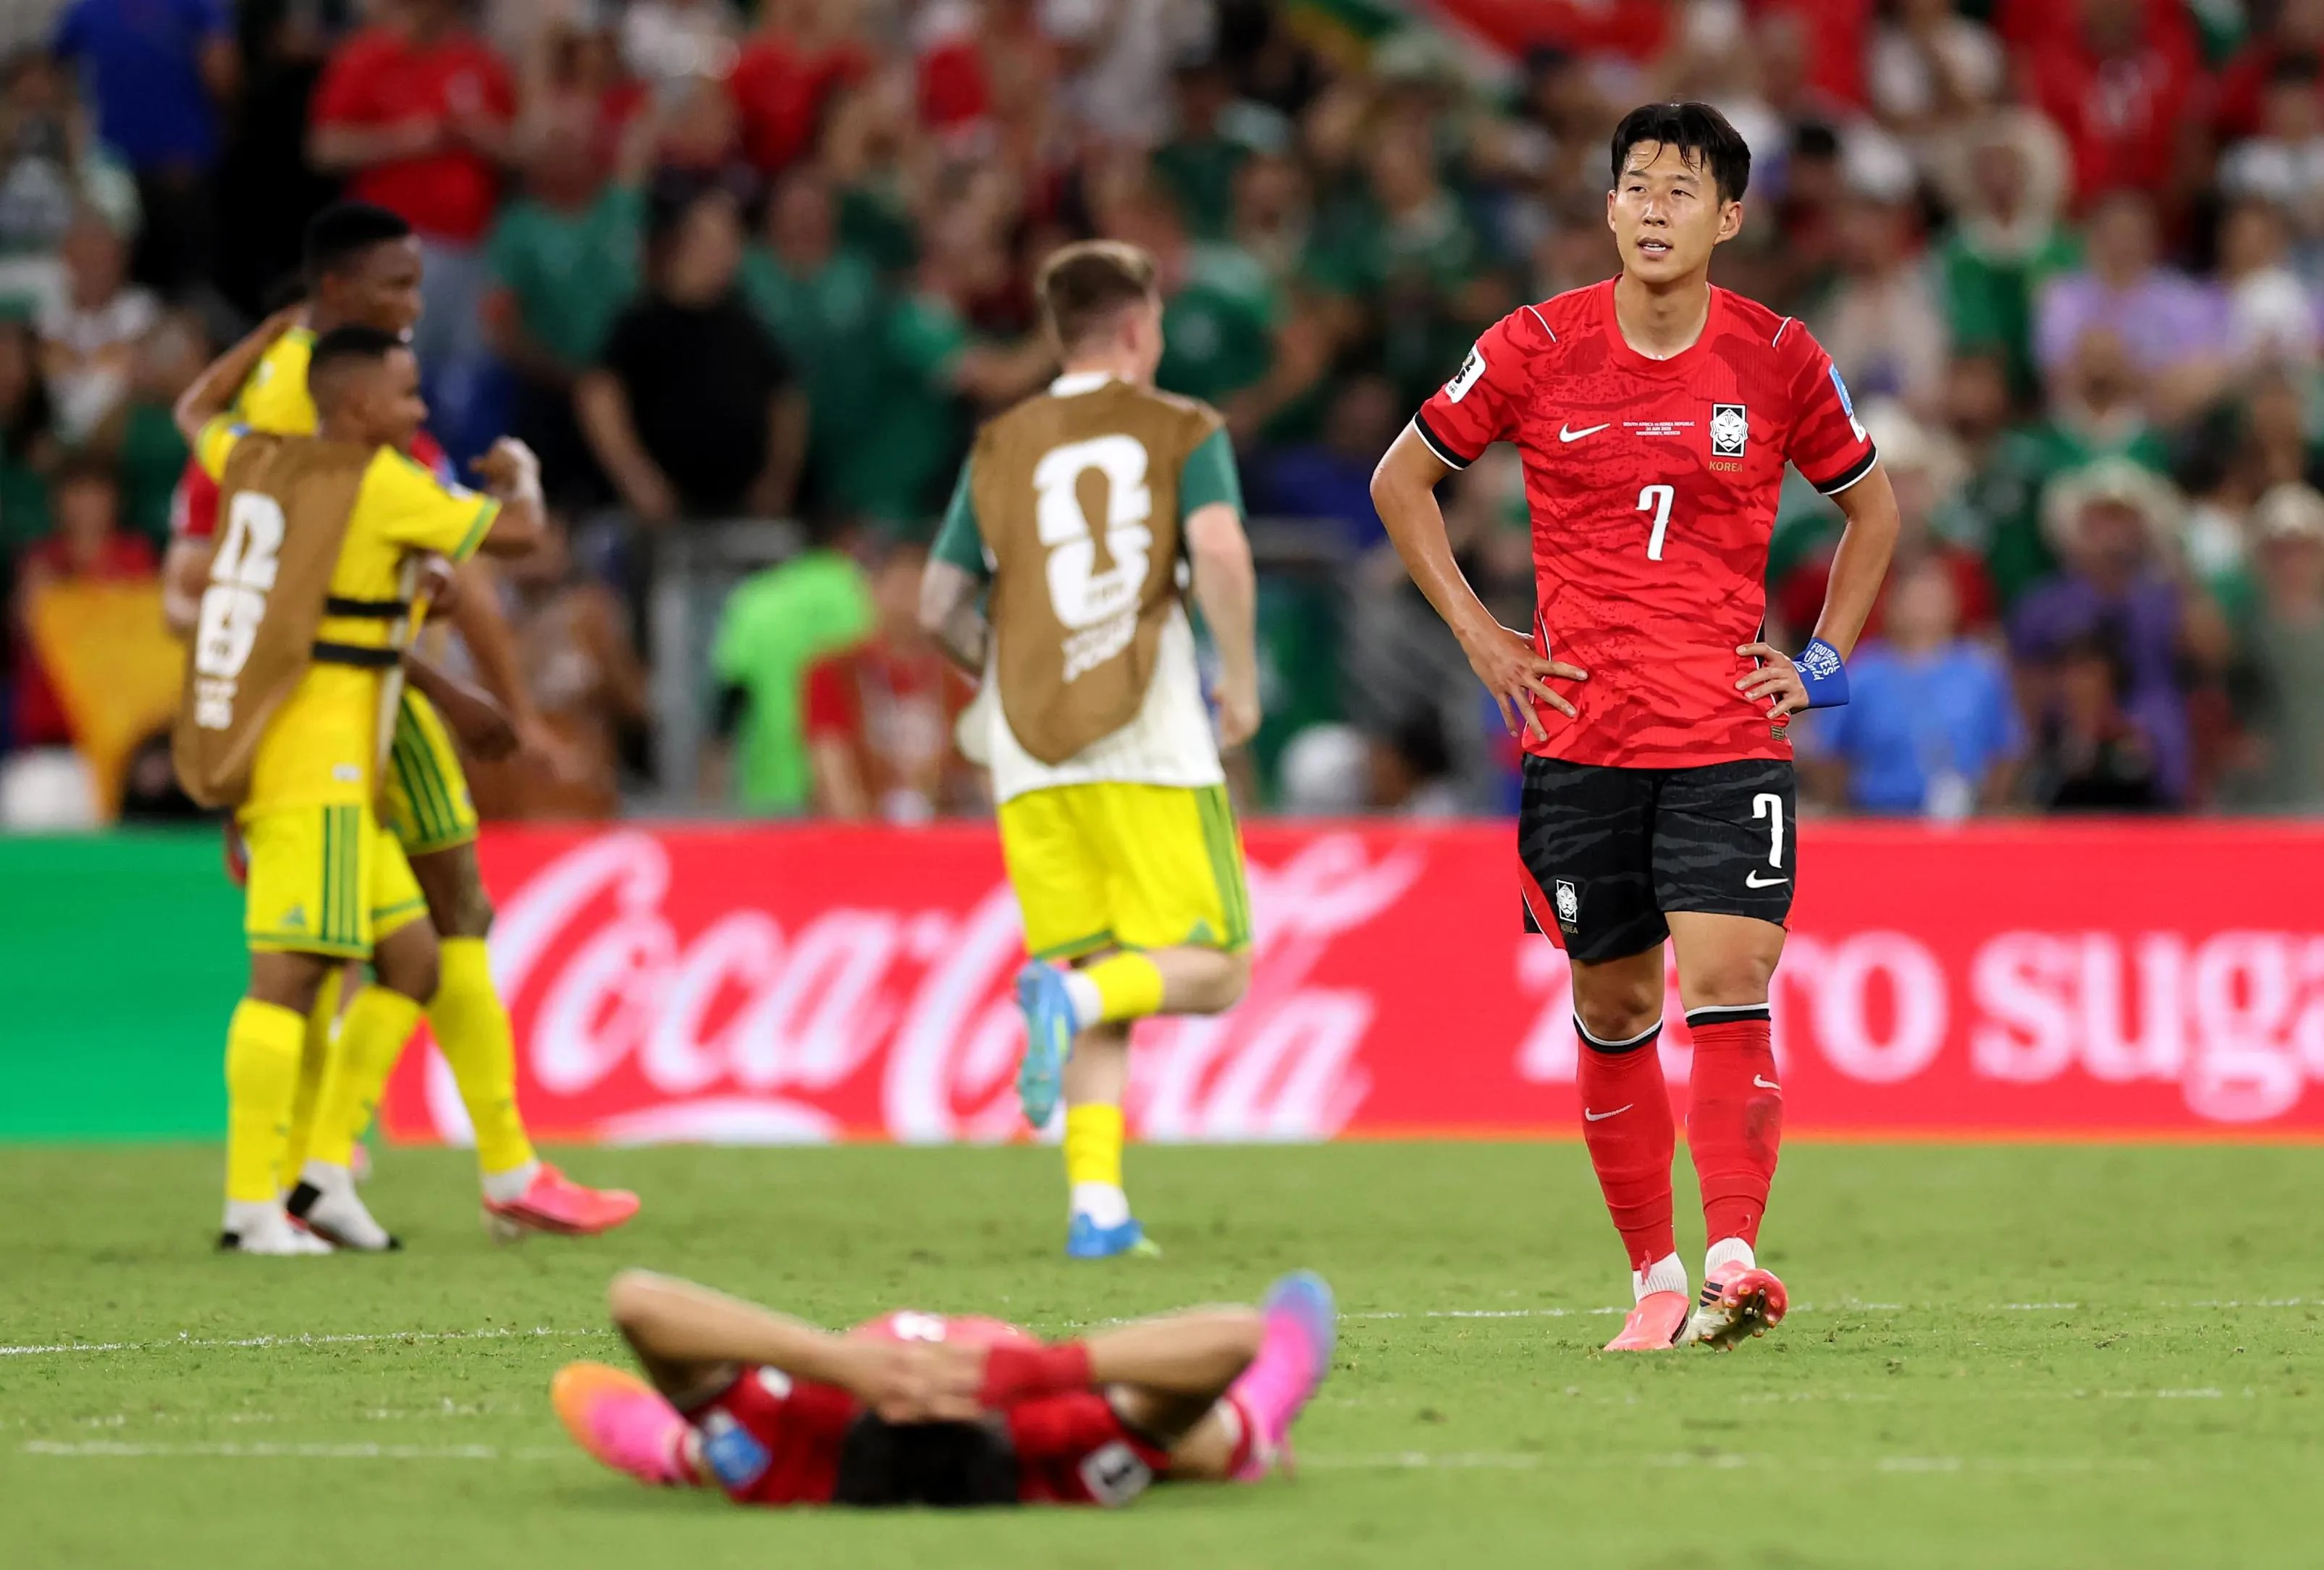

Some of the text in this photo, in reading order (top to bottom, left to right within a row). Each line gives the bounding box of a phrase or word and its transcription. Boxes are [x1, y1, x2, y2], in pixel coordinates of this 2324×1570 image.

[1709, 461, 1743, 472] KOREA
[1635, 484, 1675, 561] 7
[1803, 649, 1834, 676] UNTES
[1811, 642, 1840, 672] FOOTBALL
[1751, 793, 1784, 869] 7
[424, 830, 1423, 1144] Coca-Cla
[1514, 928, 2324, 1122] zro sug
